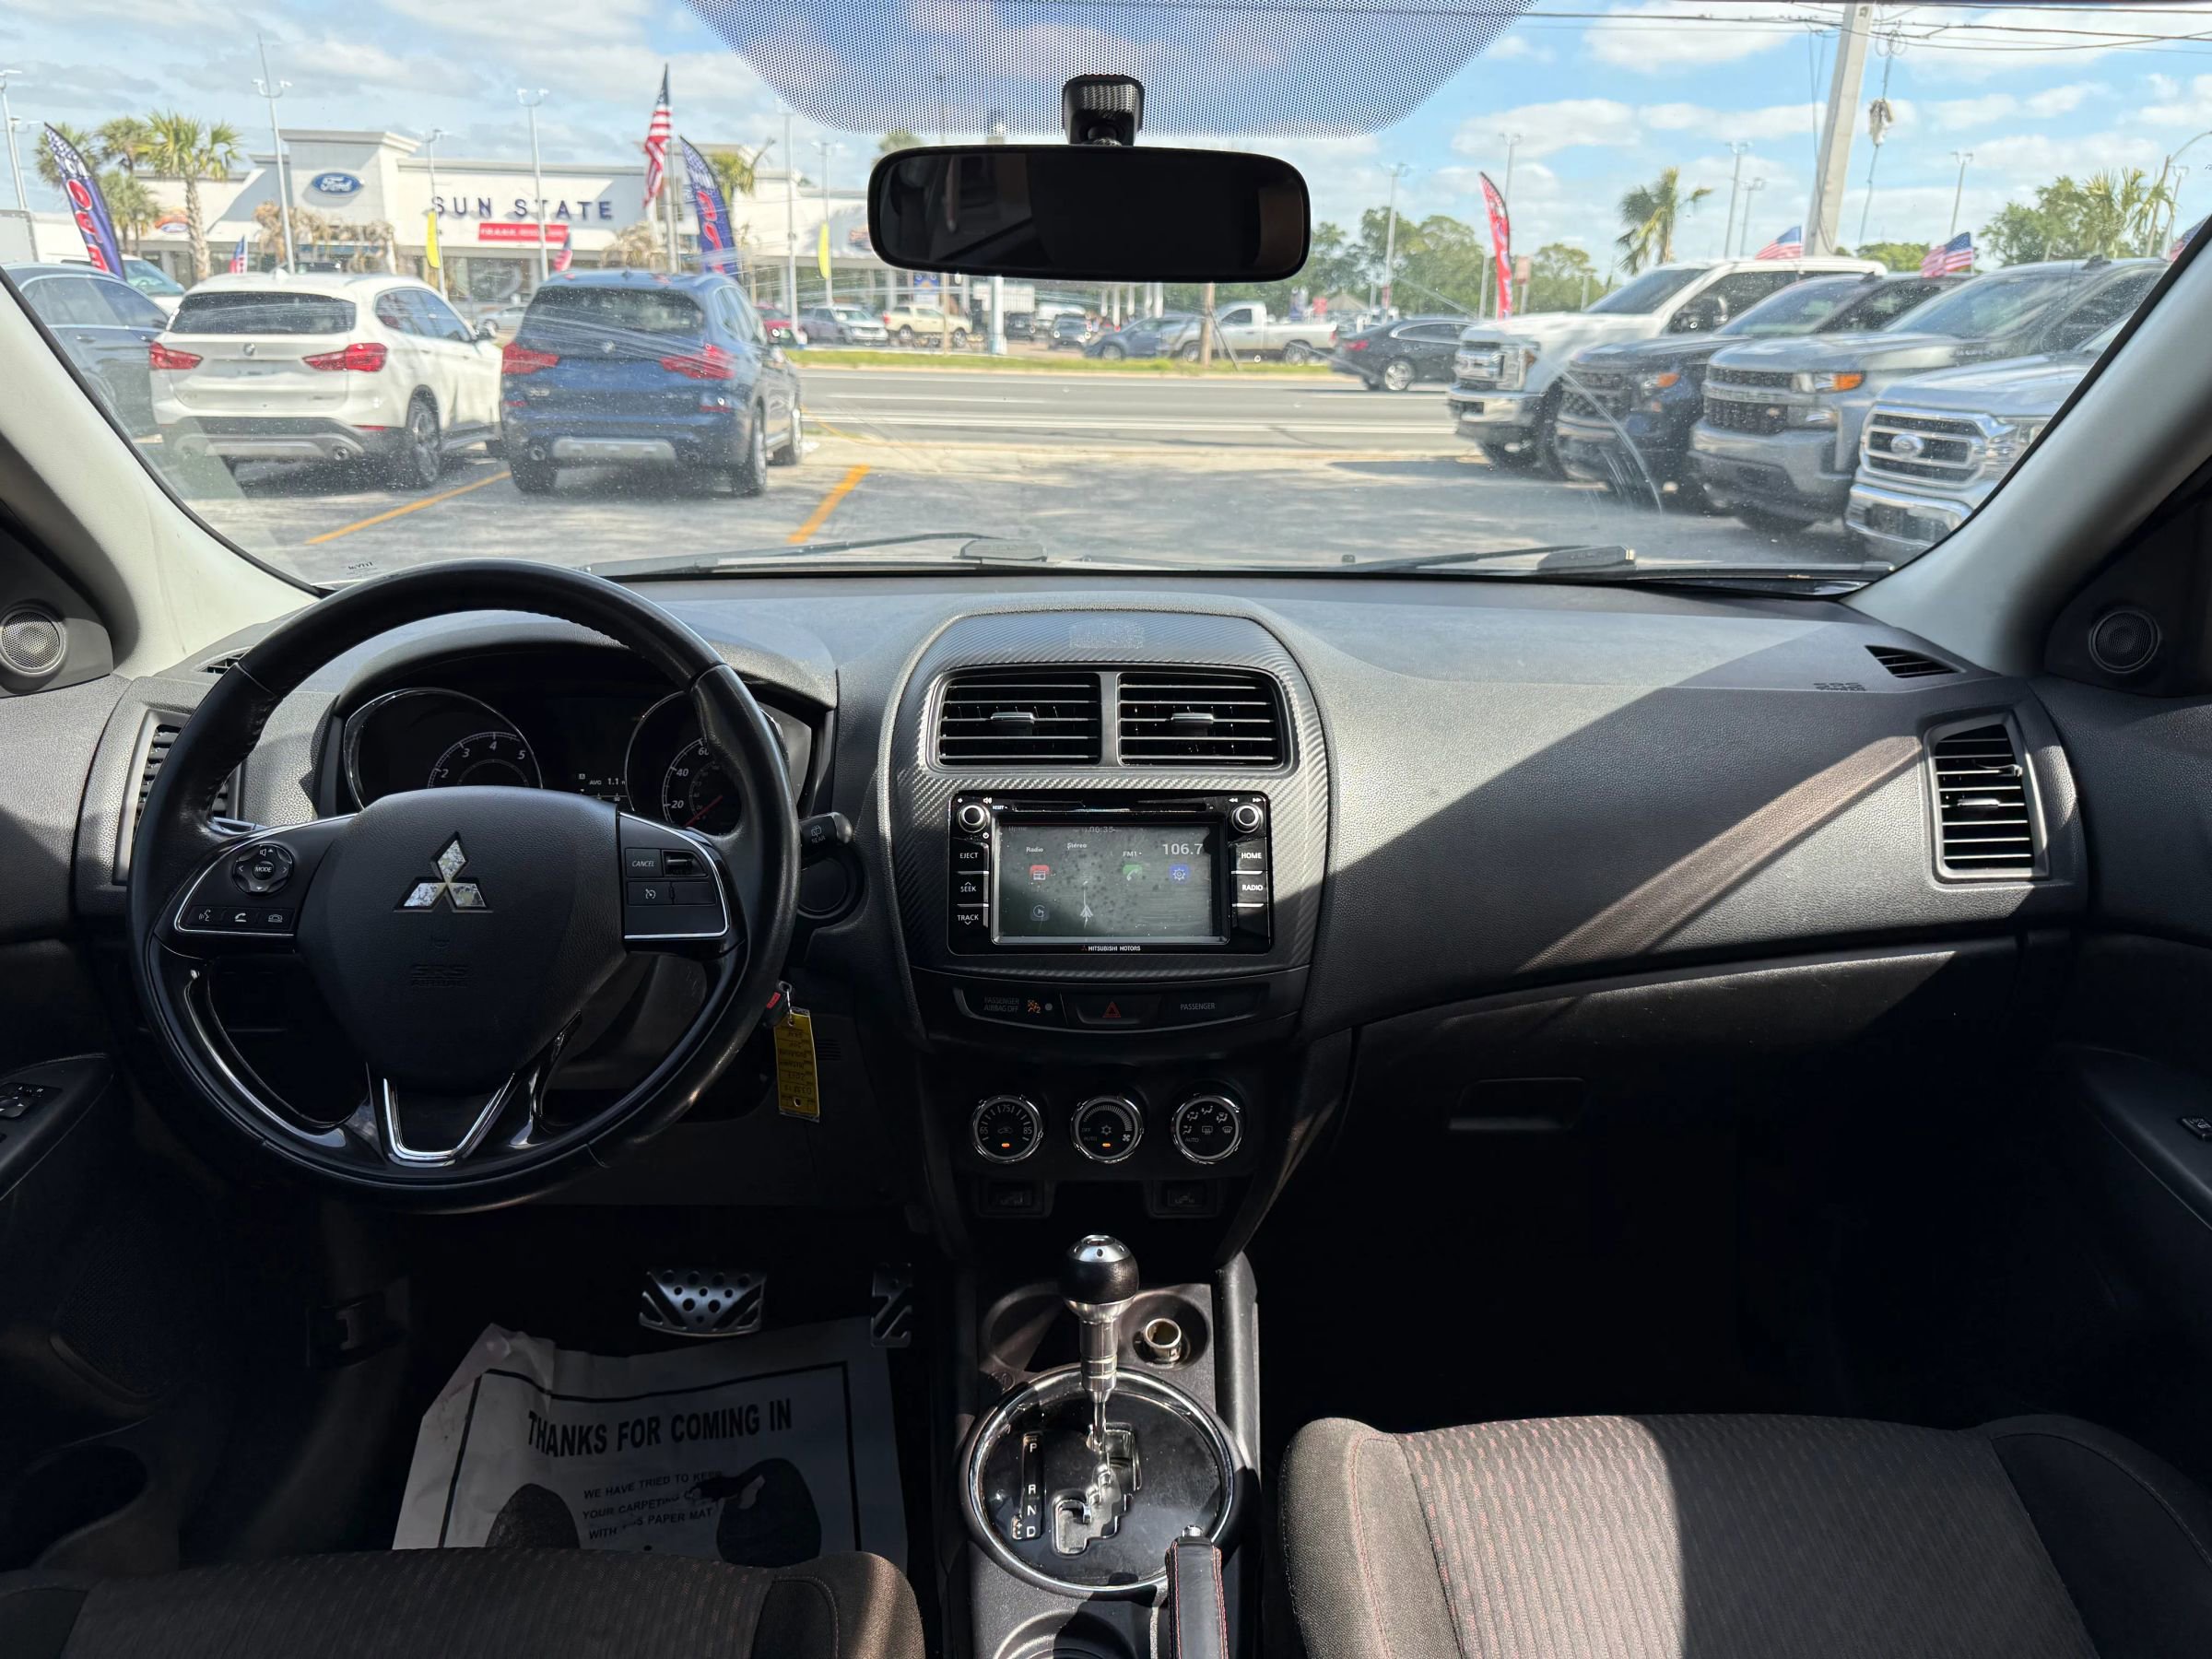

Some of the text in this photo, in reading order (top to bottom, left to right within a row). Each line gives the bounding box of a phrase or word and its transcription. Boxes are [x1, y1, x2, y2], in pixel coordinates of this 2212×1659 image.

[320, 176, 352, 192] Ford
[431, 196, 492, 218] SUN
[441, 741, 526, 778] 2 3 4 5
[676, 768, 689, 777] 40
[671, 799, 685, 809] 20
[1162, 842, 1203, 855] 106.7
[1180, 1002, 1216, 1010] PASSENGER
[1001, 1104, 1010, 1112] 75
[979, 1126, 988, 1135] 65
[1023, 1126, 1032, 1135] 85
[528, 1398, 792, 1457] THANKS FOR COMING IN
[1029, 1442, 1038, 1453] P
[583, 1488, 600, 1500] WE
[606, 1482, 635, 1496] HAVE
[640, 1476, 670, 1488] TRIED
[677, 1474, 688, 1483] TO
[1028, 1484, 1037, 1494] R
[582, 1508, 614, 1520] YOUR
[1028, 1505, 1037, 1515] N
[589, 1527, 617, 1539] WITH
[648, 1512, 685, 1524] PAPER
[689, 1507, 712, 1520] MAT
[1026, 1525, 1036, 1535] D
